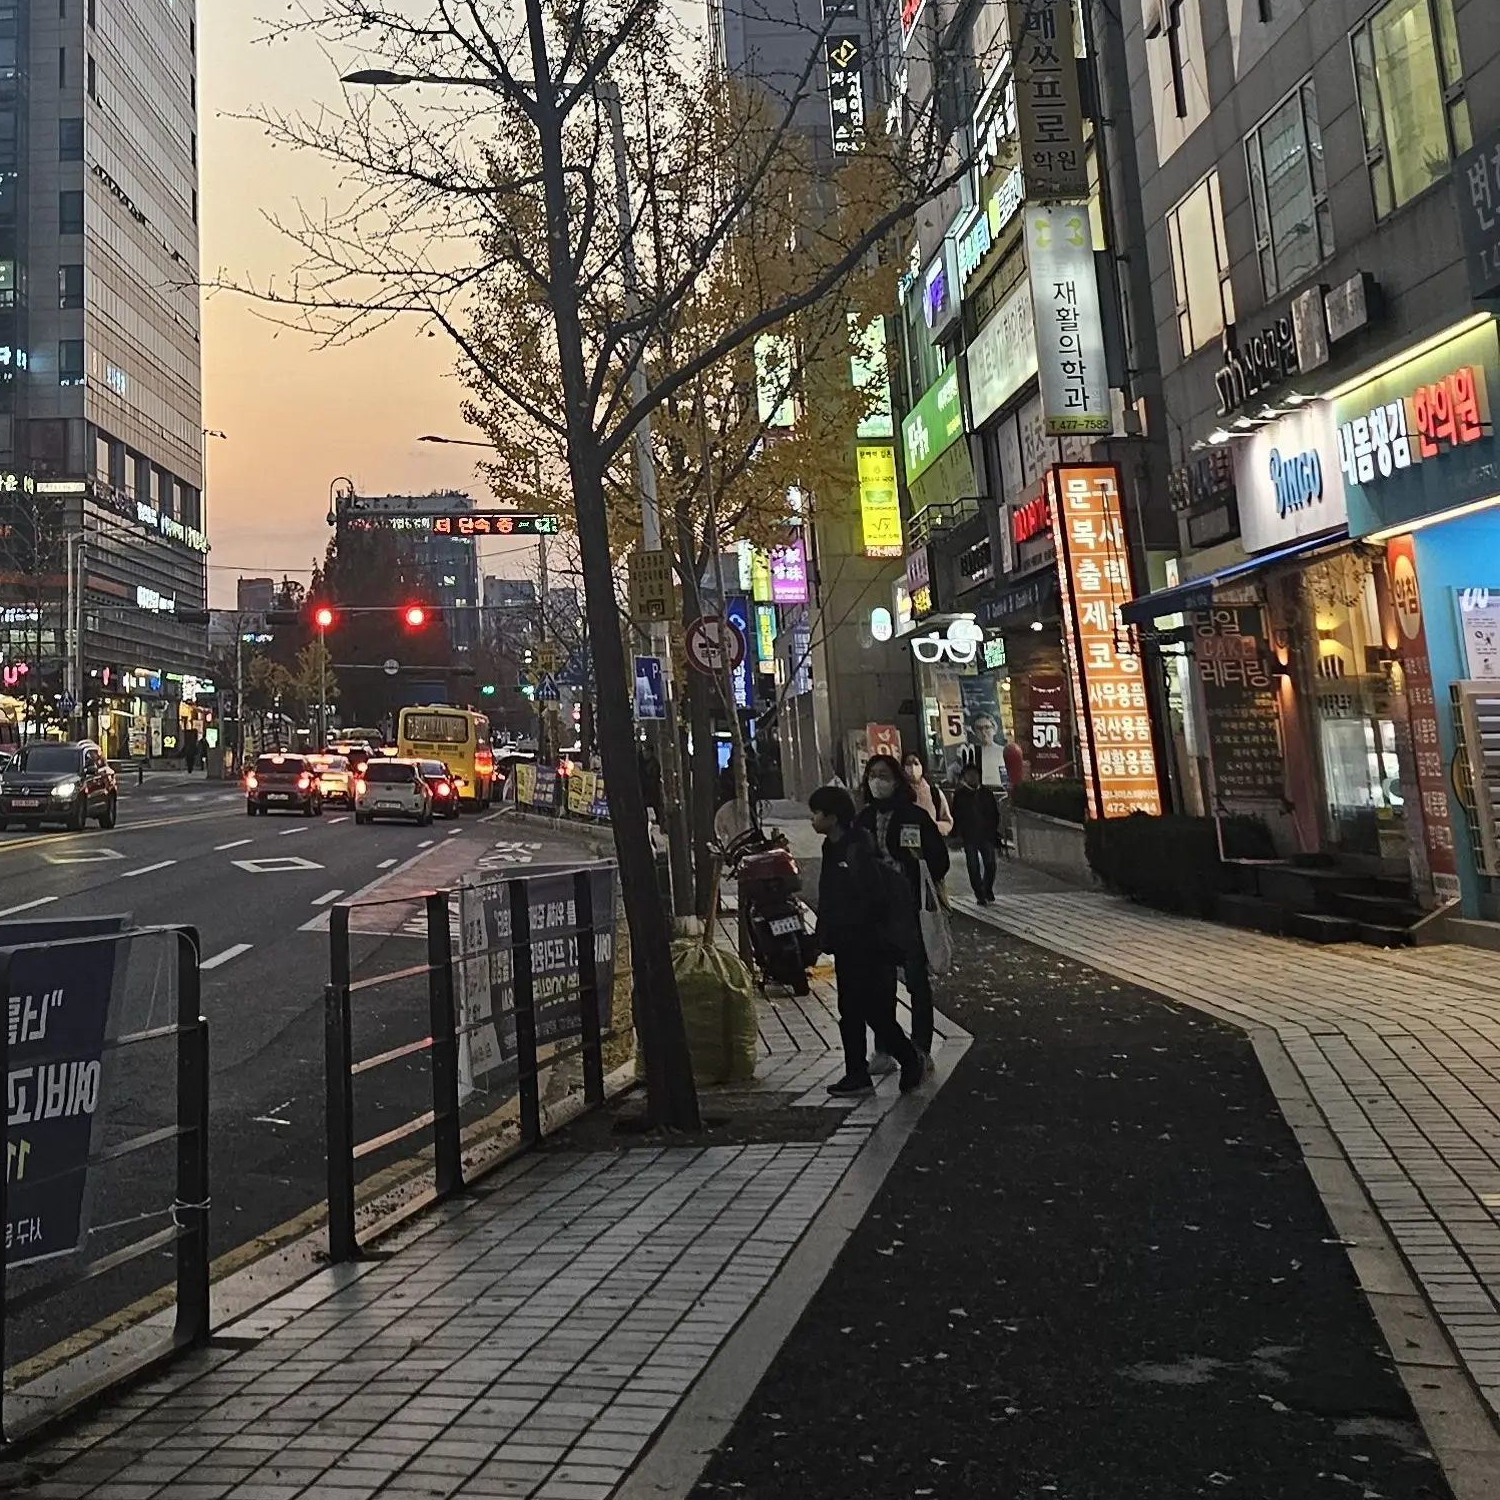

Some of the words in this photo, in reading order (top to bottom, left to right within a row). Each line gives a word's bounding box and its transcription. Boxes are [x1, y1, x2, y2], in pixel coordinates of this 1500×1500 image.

[1031, 148, 1078, 173] 학원
[1052, 280, 1091, 413] 재활의학과
[1337, 397, 1411, 486] 내몸챙김
[1411, 364, 1484, 459] 한의원
[1065, 477, 1119, 512] 문구
[1269, 446, 1324, 519] BINGO
[1070, 517, 1125, 552] 복사
[1076, 557, 1130, 592] 출력
[1202, 638, 1255, 659] CAKE
[1199, 659, 1271, 689] 레터링
[1089, 681, 1146, 709] 사무용품
[1093, 715, 1152, 742] 전산용품
[1098, 749, 1155, 777] 생활용품
